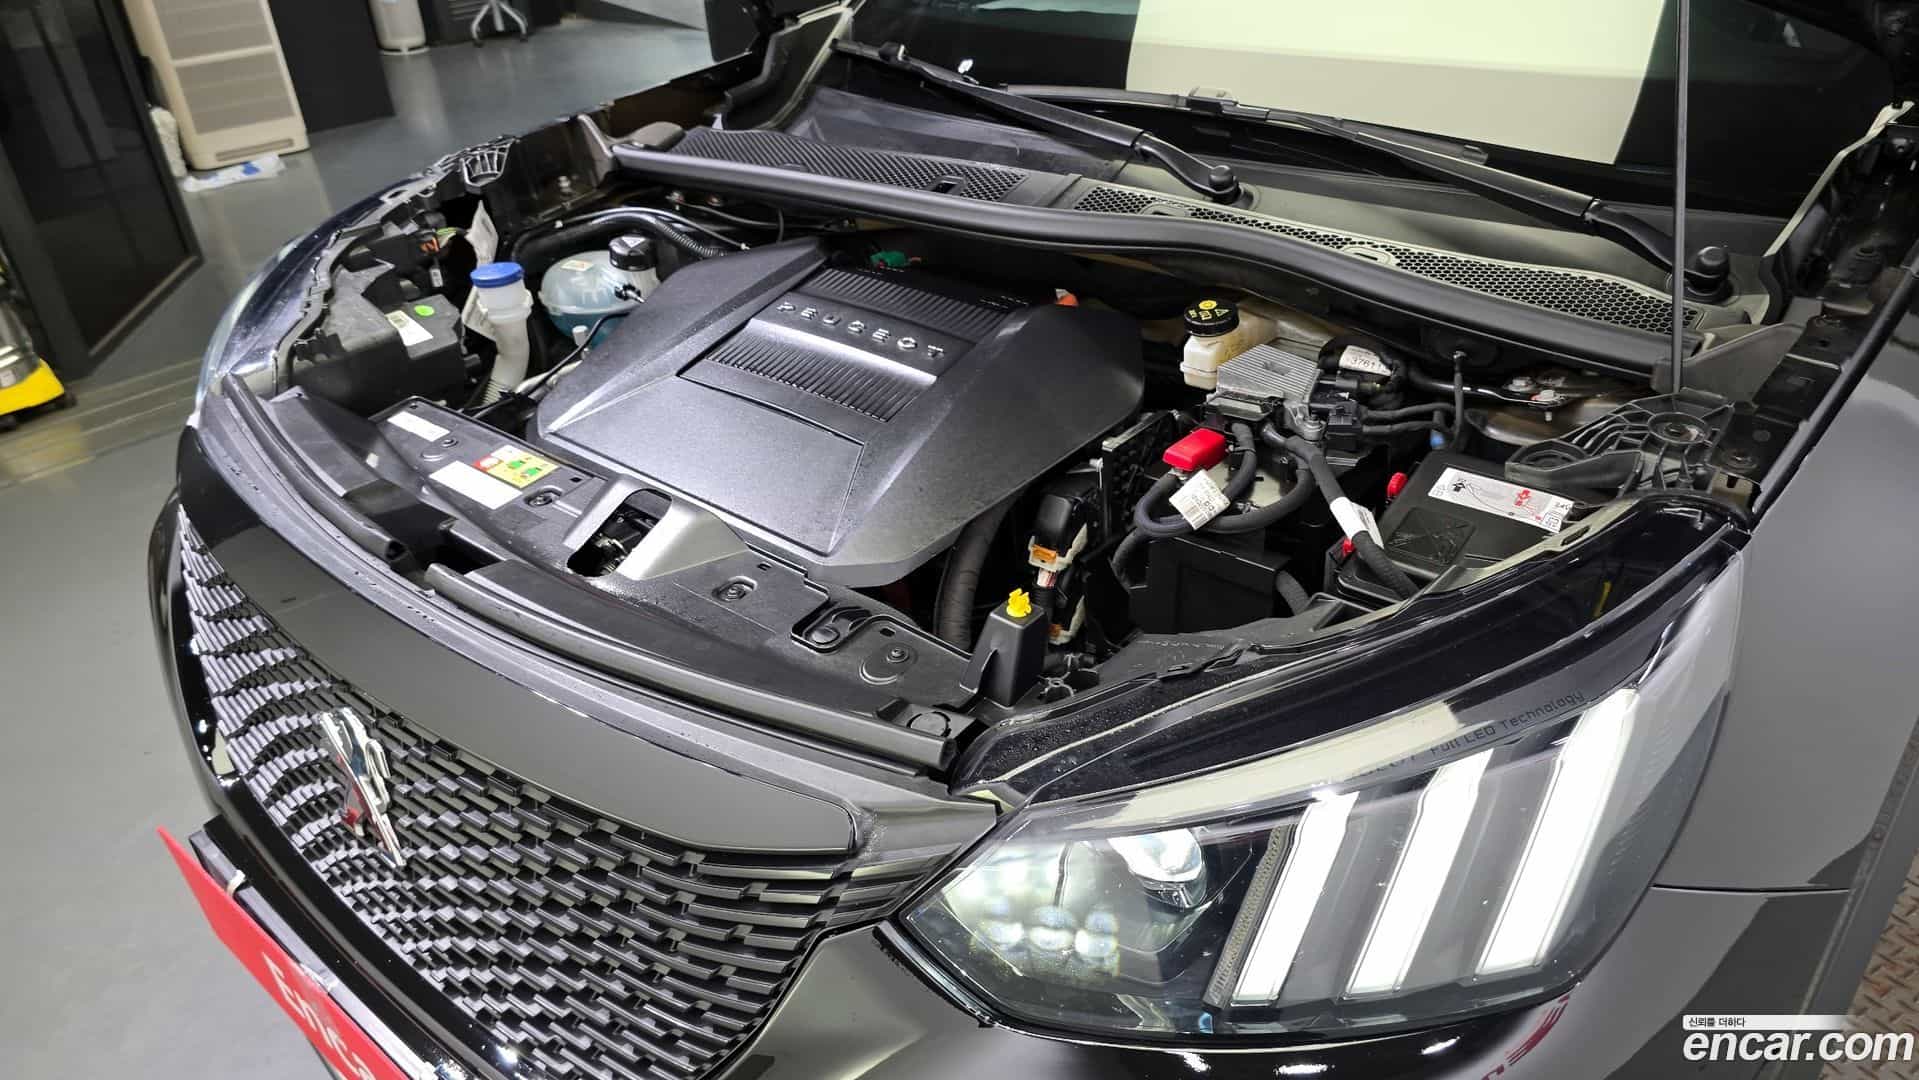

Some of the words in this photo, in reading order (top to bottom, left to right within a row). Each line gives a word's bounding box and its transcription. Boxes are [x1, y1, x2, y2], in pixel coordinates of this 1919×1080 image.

[776, 301, 944, 359] PEUGEOT
[1464, 726, 1496, 744] LED
[1502, 690, 1585, 730] Technology
